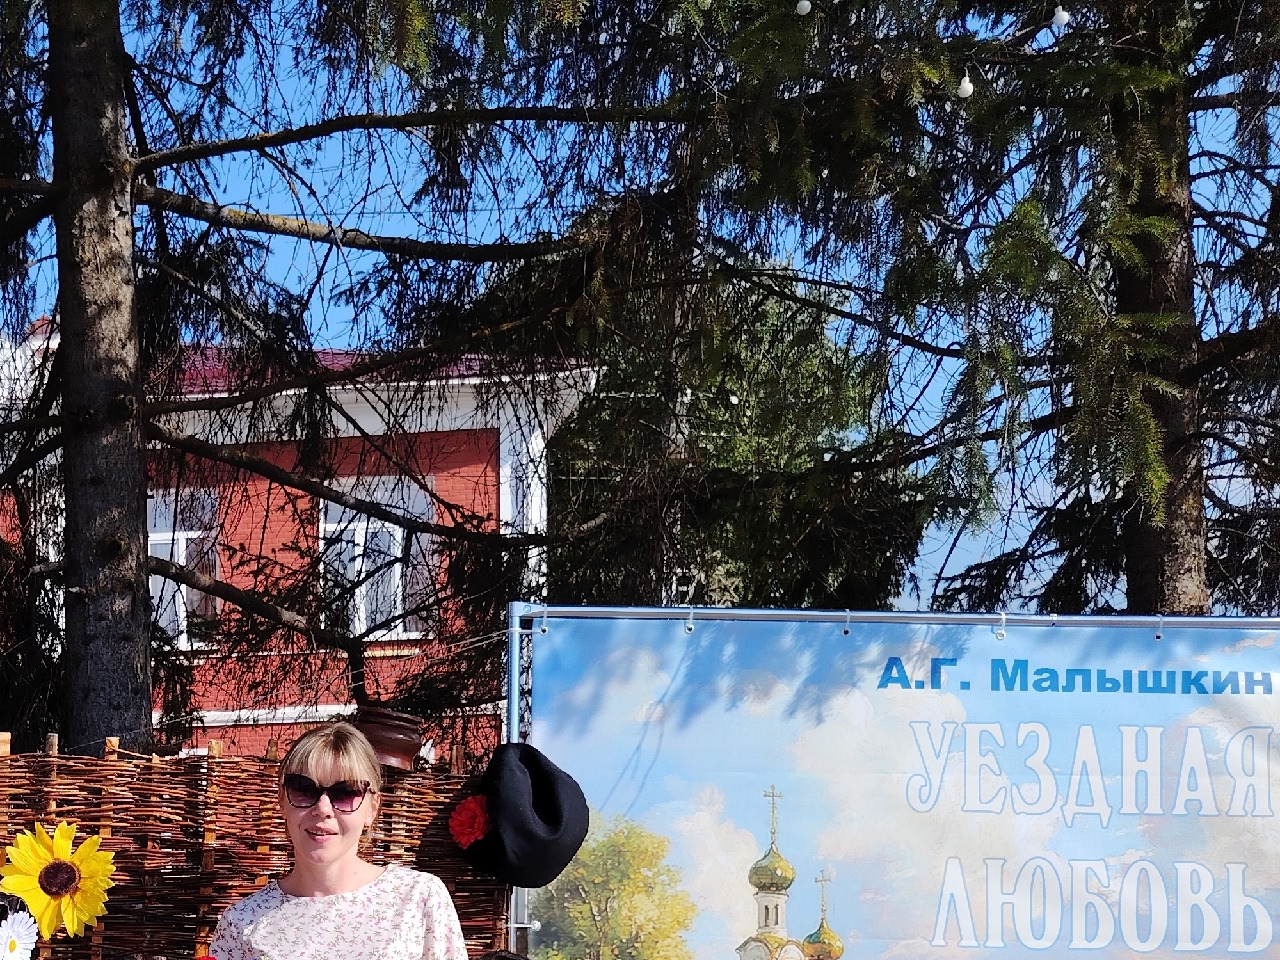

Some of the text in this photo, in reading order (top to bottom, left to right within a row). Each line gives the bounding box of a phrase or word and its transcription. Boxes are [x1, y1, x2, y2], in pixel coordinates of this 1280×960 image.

[876, 656, 1274, 696] А.Г. Малышкин
[905, 721, 1275, 829] УЕЗДНАЯ
[931, 856, 1274, 953] ЛЮБОВЬ
